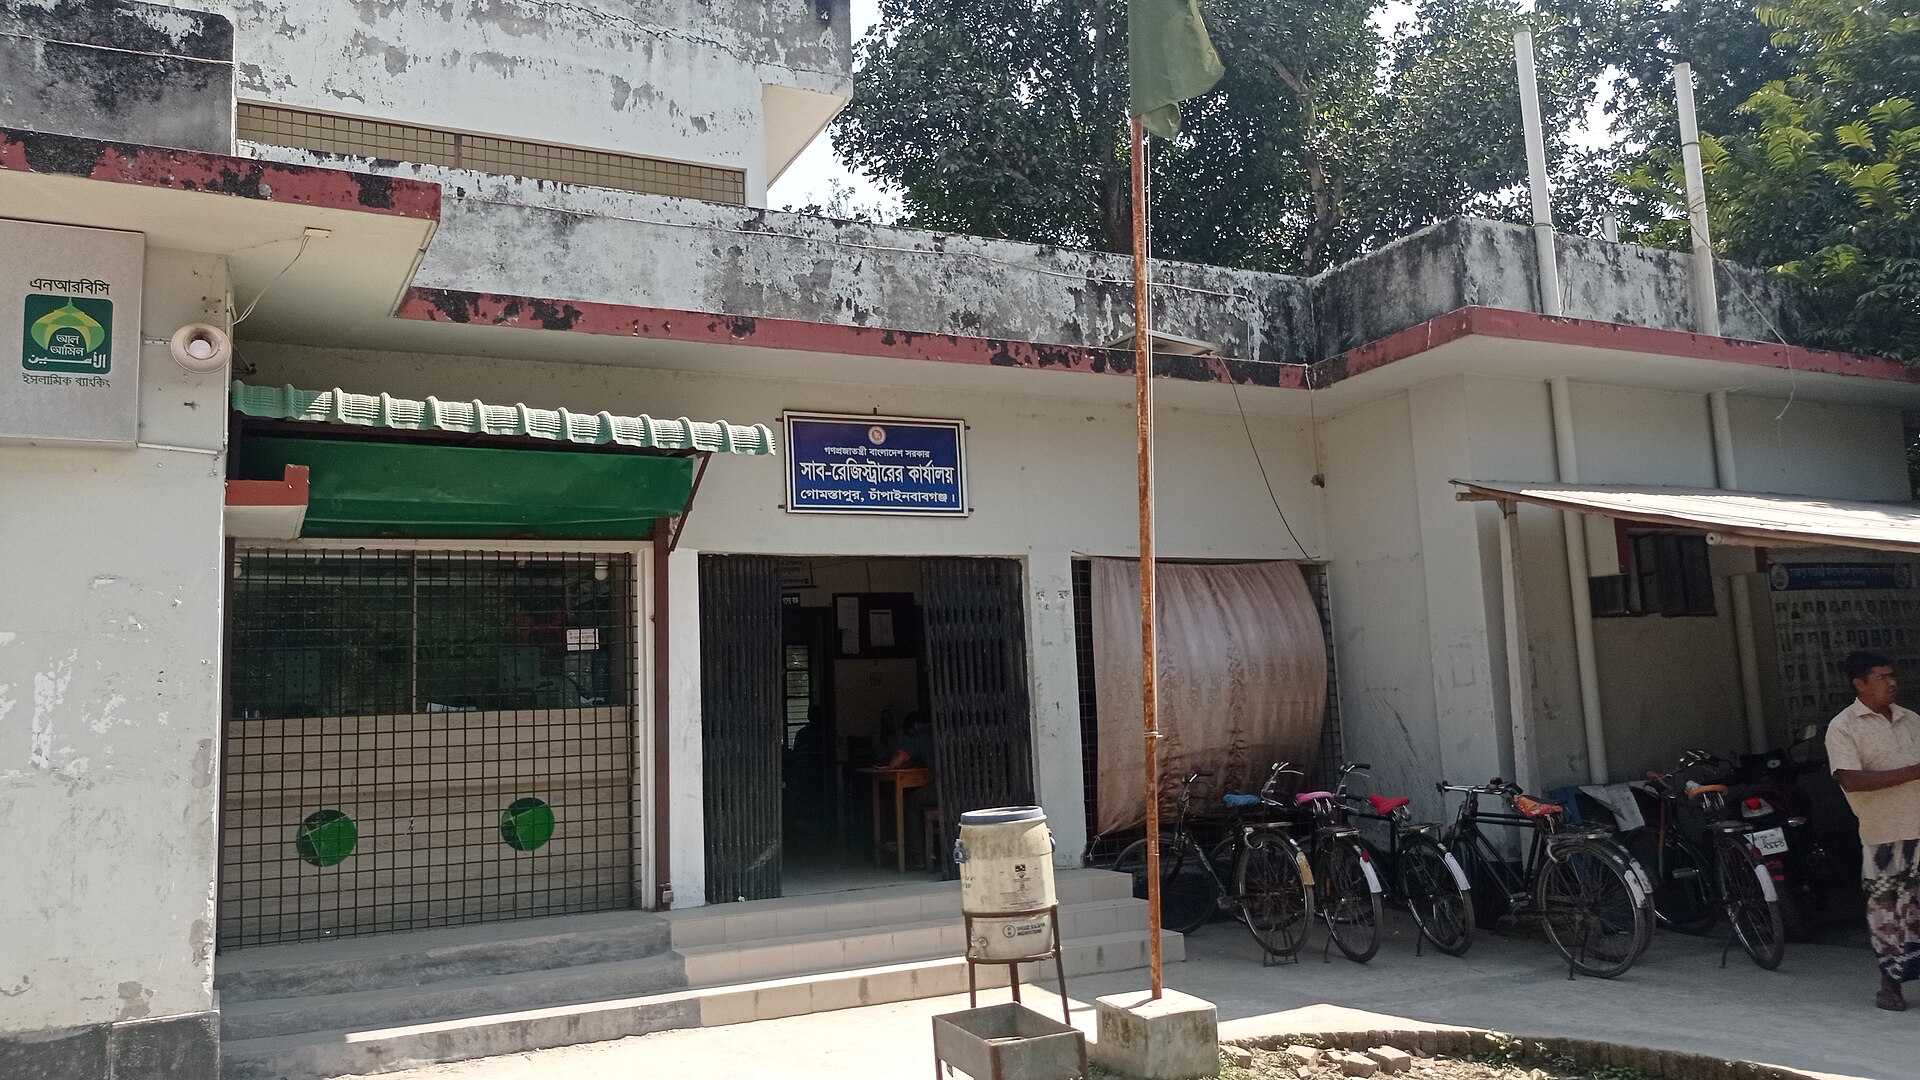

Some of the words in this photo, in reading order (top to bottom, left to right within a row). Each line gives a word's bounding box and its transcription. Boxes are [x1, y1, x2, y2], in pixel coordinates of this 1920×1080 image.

[30, 279, 110, 295] এনআরবিসি
[56, 334, 80, 345] আল
[50, 344, 85, 356] আমিন
[22, 372, 72, 385] ইসলামিক
[75, 376, 111, 387] ব্যাংকিং
[824, 446, 867, 456] গণপ্রজাতন্ত্রী
[869, 448, 903, 458] বাংলাদেশ
[905, 450, 930, 458] সরকার
[800, 457, 905, 485] সাব-রেজিস্ট্রারের
[906, 460, 954, 485] কার্যালয়
[801, 488, 865, 502] গোমস্তাপুর,
